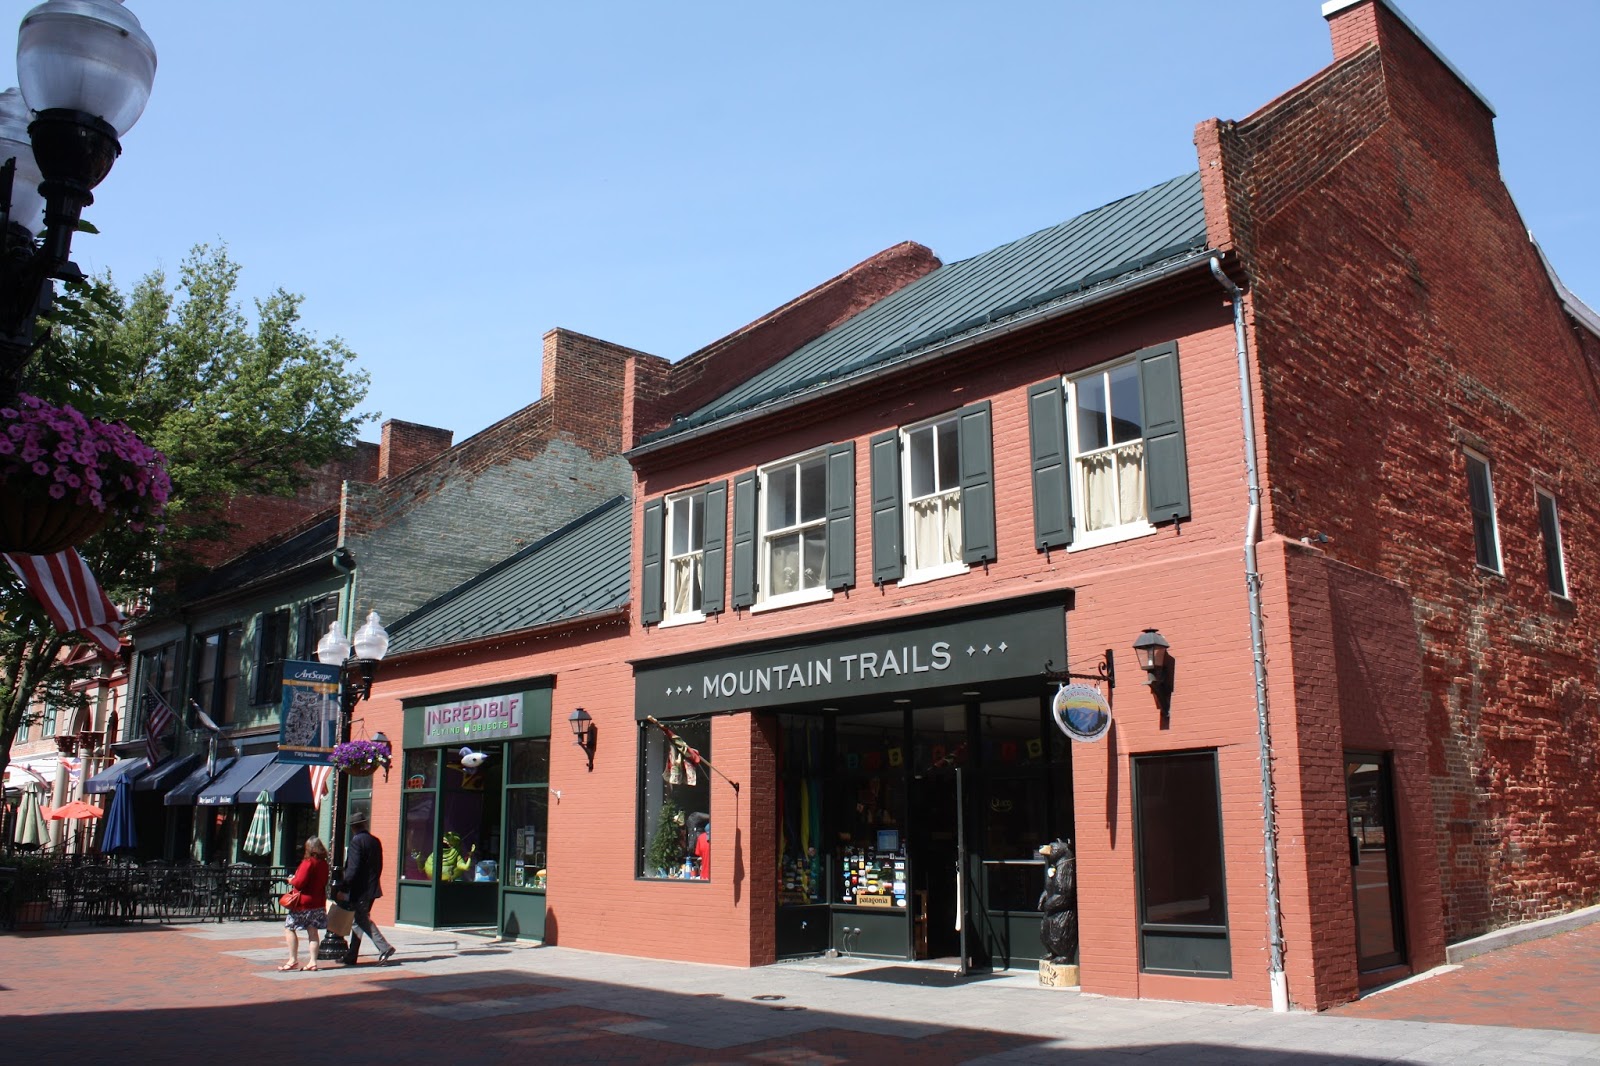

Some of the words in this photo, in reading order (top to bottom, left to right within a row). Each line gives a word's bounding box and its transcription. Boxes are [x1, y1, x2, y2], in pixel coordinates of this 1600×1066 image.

[294, 669, 332, 681] ArtScape
[703, 658, 832, 699] MOUNTAIN
[840, 641, 952, 681] TRAILS
[427, 699, 519, 736] INCREDIBLE
[432, 726, 460, 737] FLYING
[472, 720, 509, 733] OBJECTS
